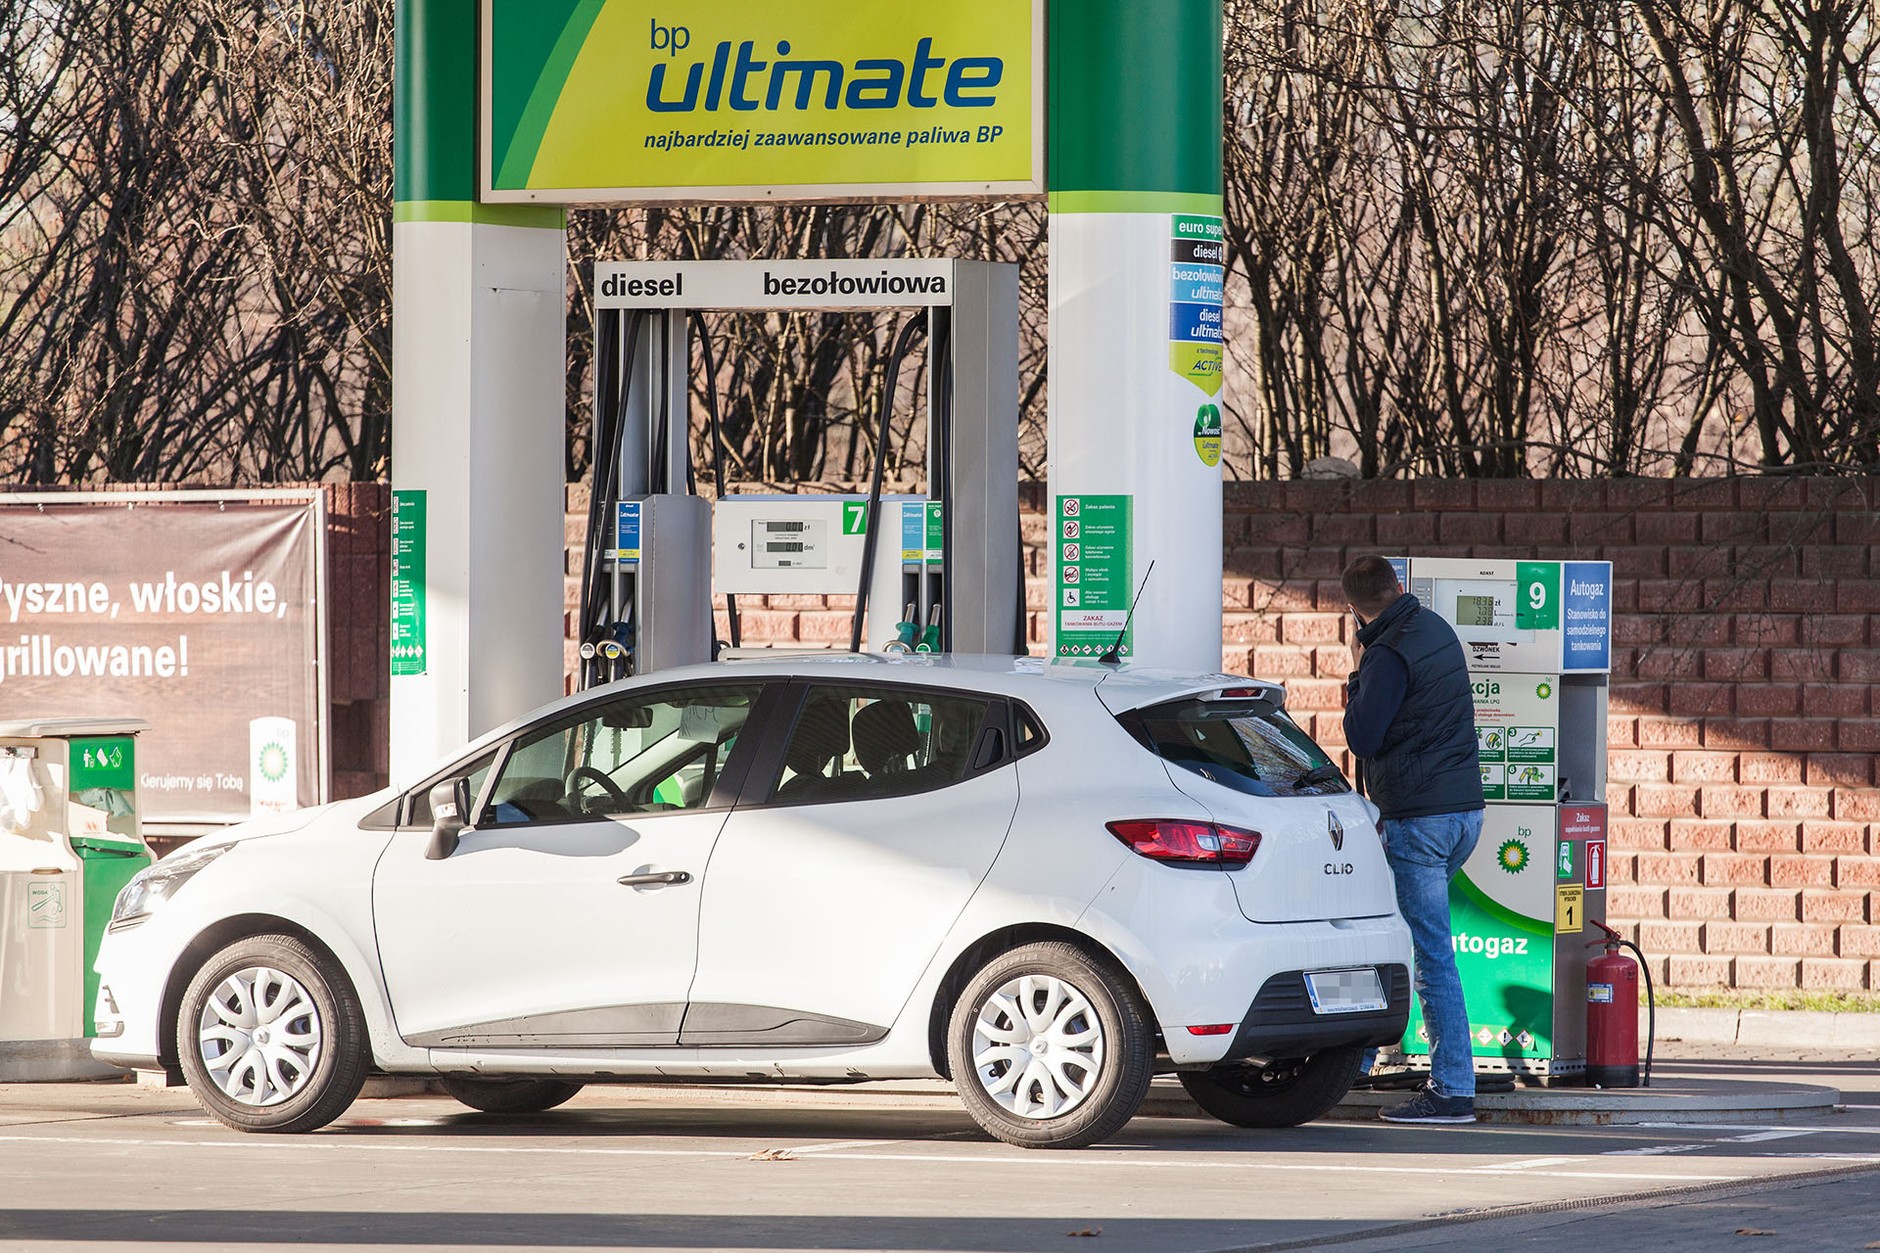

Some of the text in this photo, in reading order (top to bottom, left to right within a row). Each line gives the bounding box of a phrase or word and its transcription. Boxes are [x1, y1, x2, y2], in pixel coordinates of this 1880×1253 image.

[651, 18, 690, 57] bp
[646, 37, 1004, 112] ultimate
[644, 125, 1003, 152] najbardziej zaawansowane paliwa BP
[1179, 222, 1222, 237] euro supe
[1193, 244, 1217, 259] diesel
[601, 270, 946, 297] diesel bezołowiowa
[1199, 308, 1221, 323] diesel
[848, 506, 865, 533] 7
[0, 571, 287, 623] yszne, włoskie,
[1529, 582, 1547, 609] 9
[1570, 579, 1604, 600] Autogaz
[1567, 608, 1607, 620] Stanowisko do
[1567, 624, 1606, 638] samodzielnego
[1571, 640, 1602, 651] tankowania
[0, 634, 189, 684] rillowane!
[140, 773, 243, 792] Kierujemy się Tobą
[1518, 826, 1531, 838] bp
[1324, 863, 1353, 875] CLIO
[1566, 906, 1573, 925] 1
[1451, 932, 1528, 959] togaz
